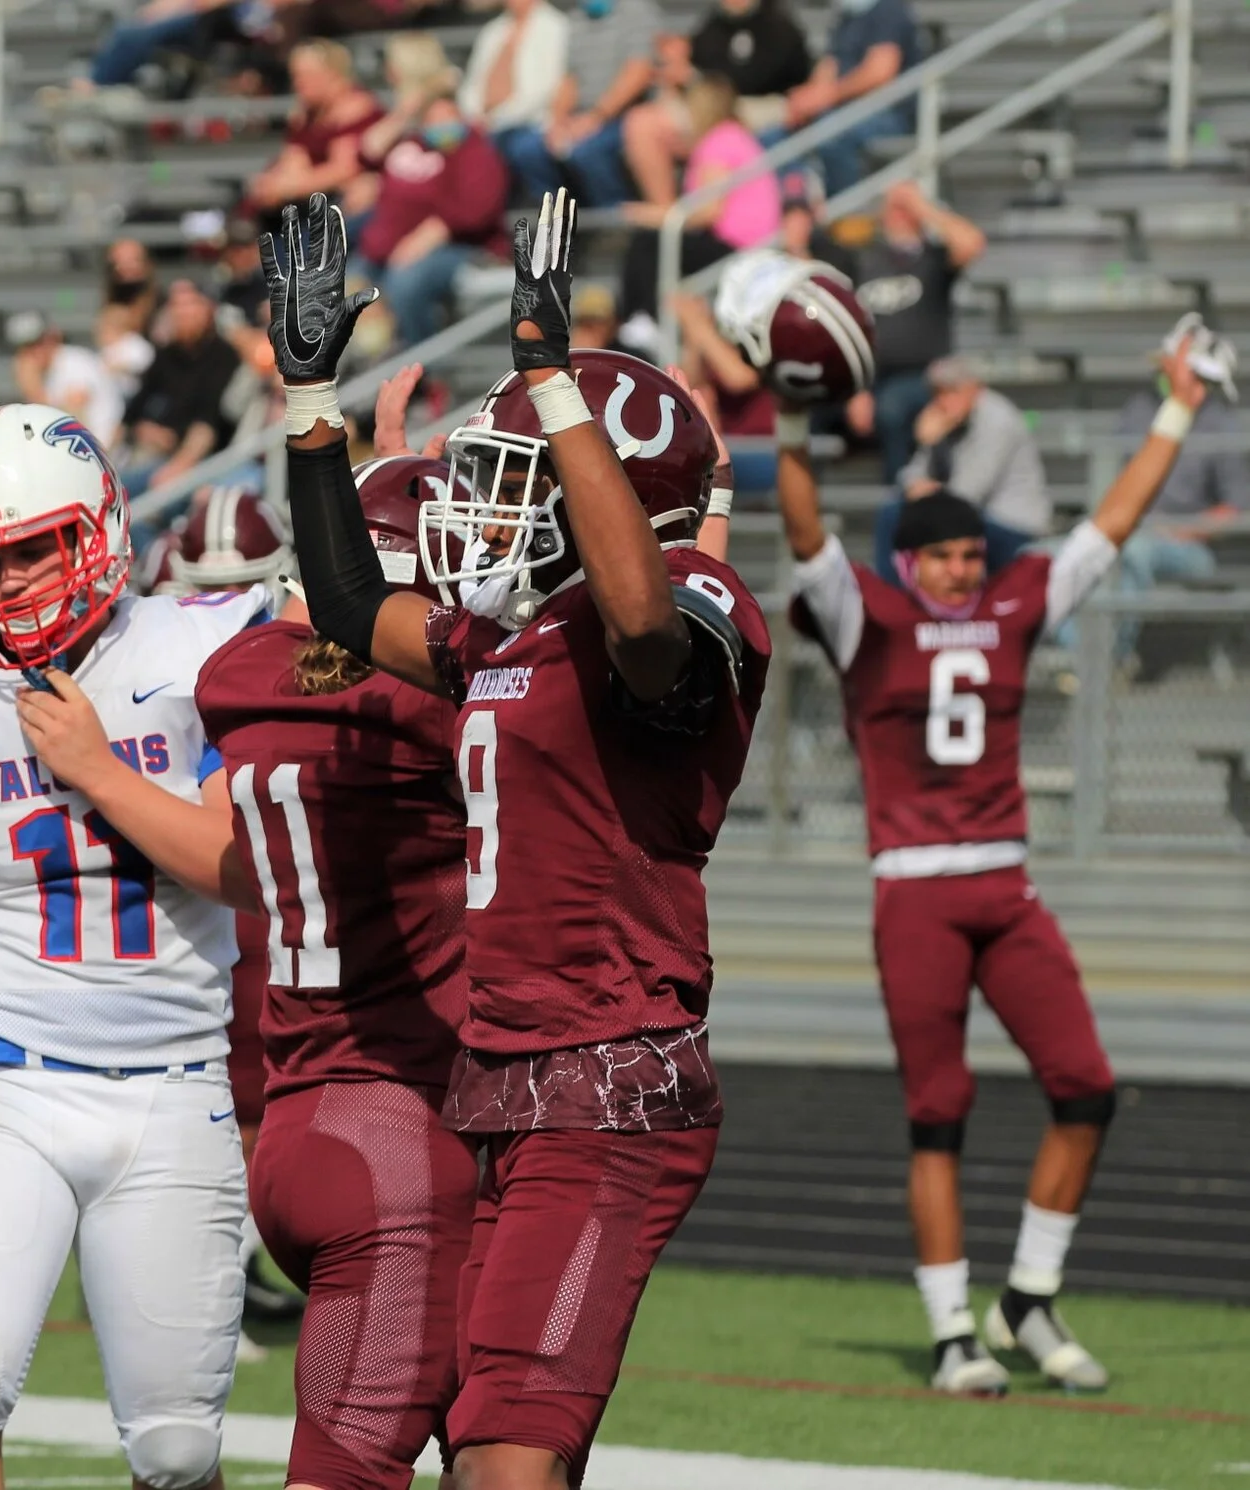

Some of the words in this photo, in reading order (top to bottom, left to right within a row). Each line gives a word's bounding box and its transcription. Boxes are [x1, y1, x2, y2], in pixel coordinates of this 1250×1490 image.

[926, 649, 991, 766] 6
[8, 803, 157, 962] 11
[231, 762, 341, 989] 11
[458, 710, 500, 910] 9
